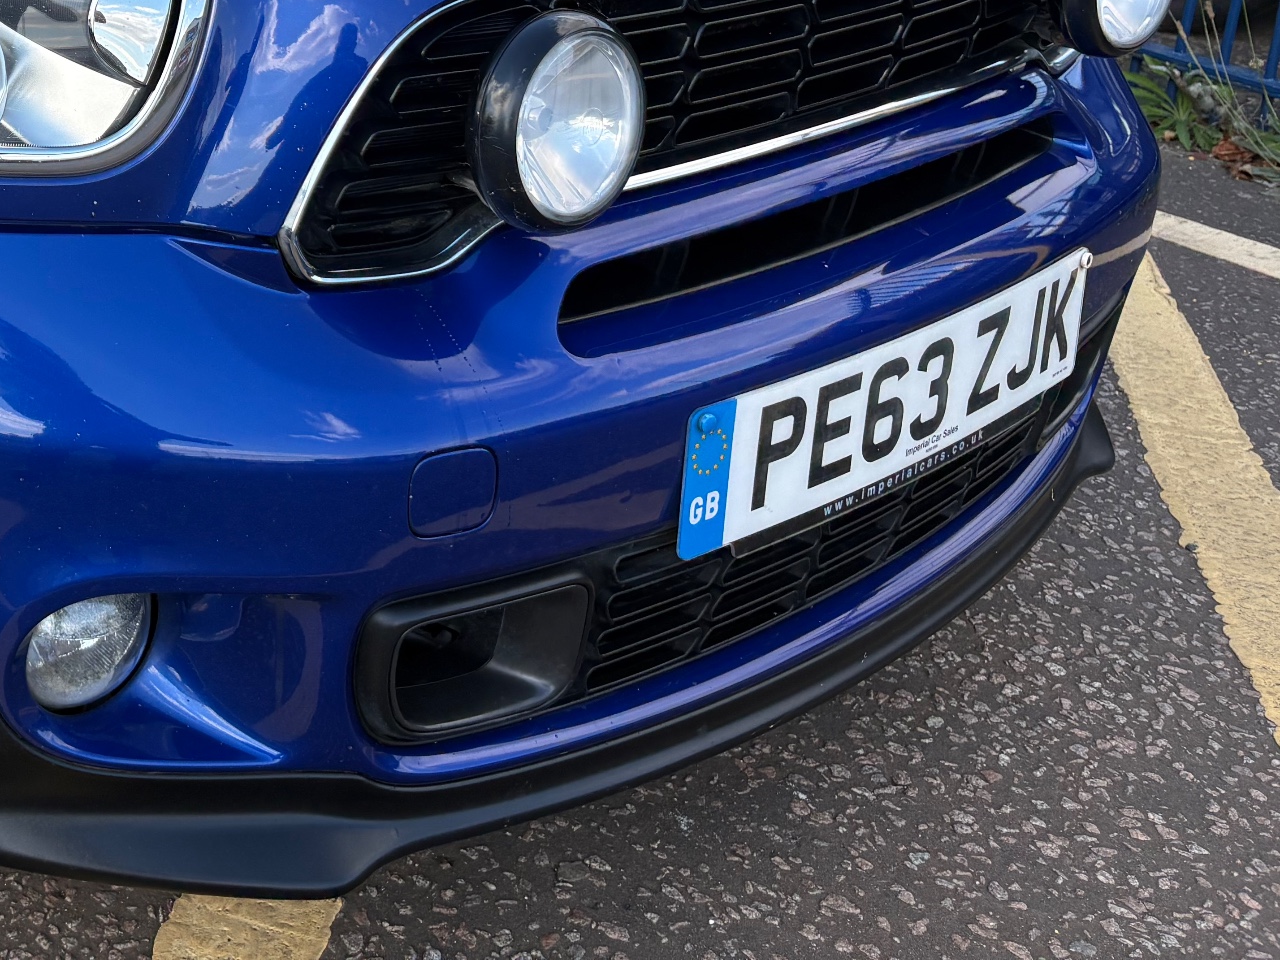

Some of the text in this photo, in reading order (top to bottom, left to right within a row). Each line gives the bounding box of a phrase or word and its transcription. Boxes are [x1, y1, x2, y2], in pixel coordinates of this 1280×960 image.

[750, 268, 1080, 512] PE63 ZJK
[905, 438, 931, 458] Imperial
[931, 432, 943, 445] Car
[943, 424, 959, 440] Sales
[823, 430, 984, 517] www.imperialcars.co.uk
[689, 490, 720, 525] GB
